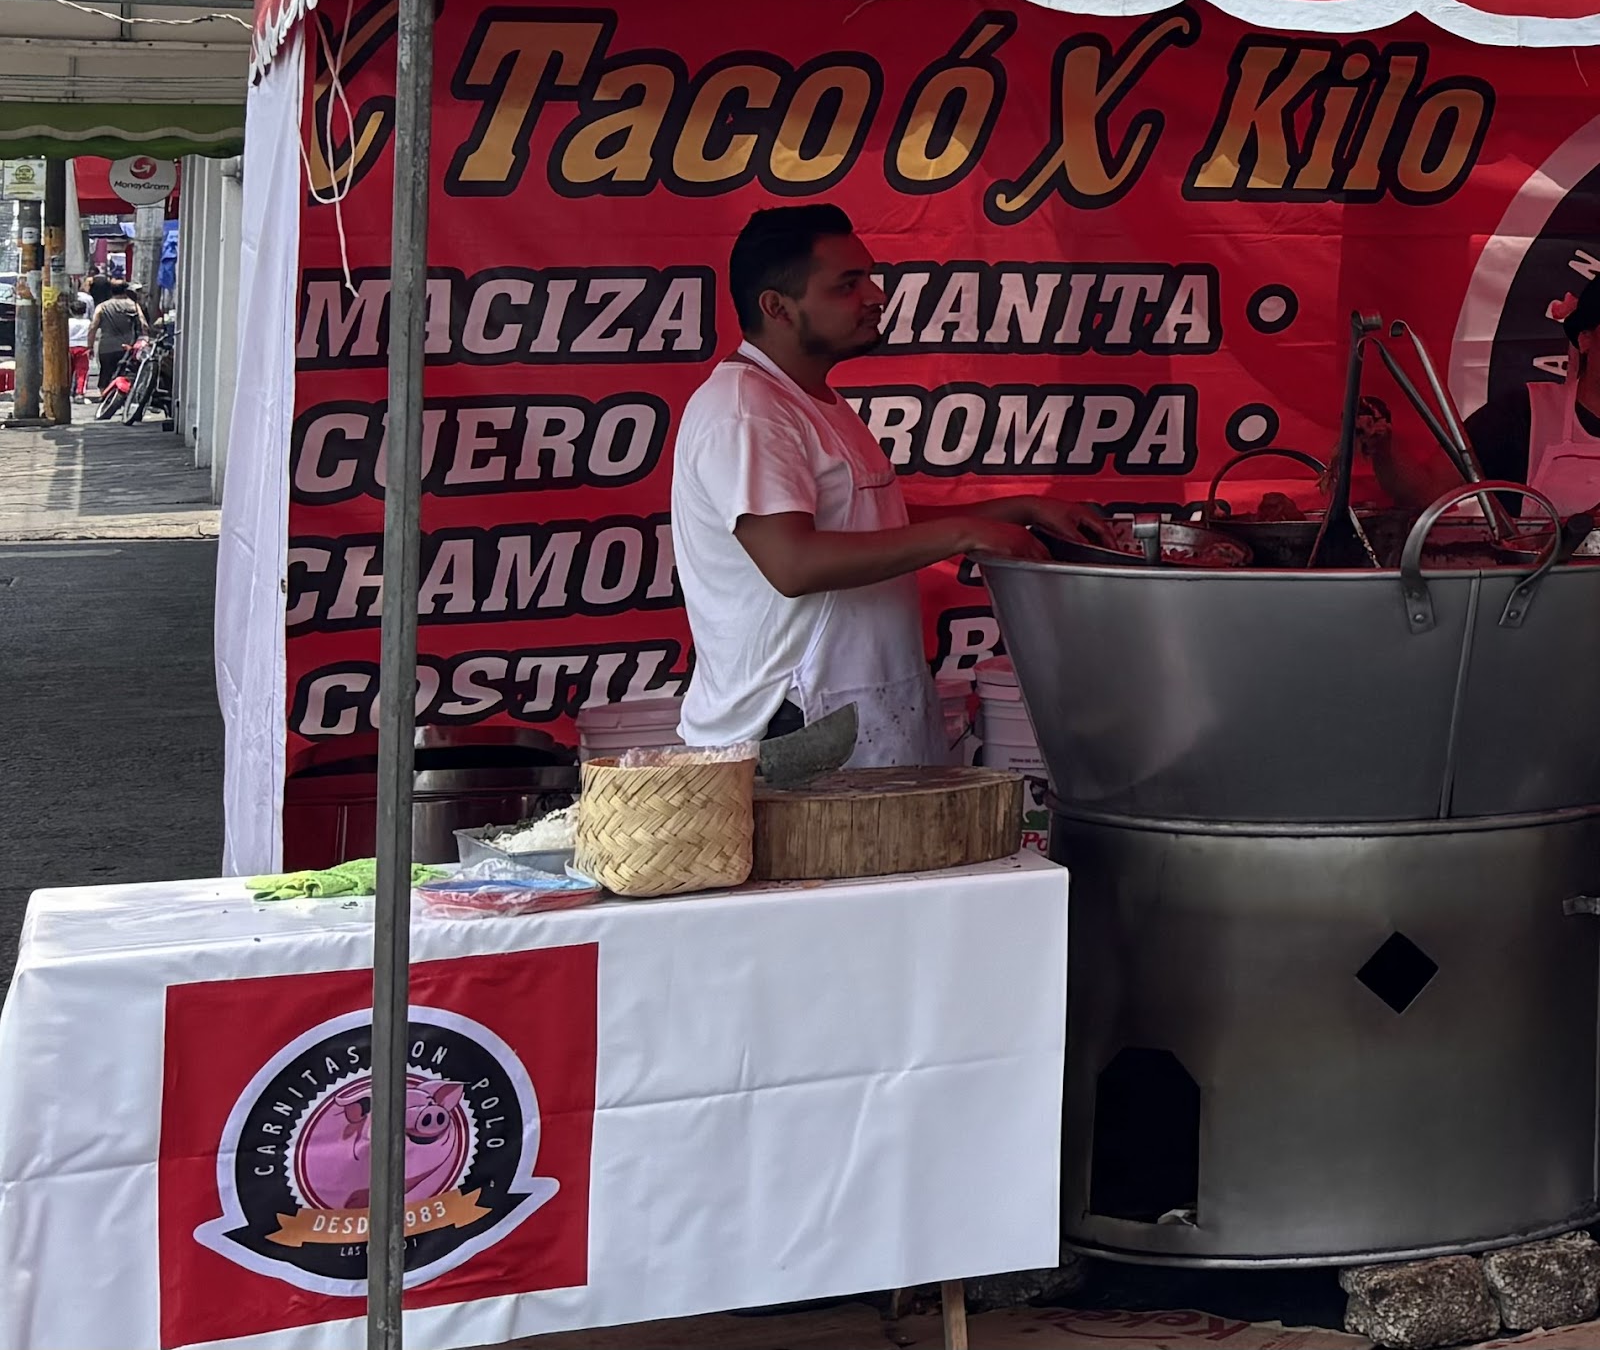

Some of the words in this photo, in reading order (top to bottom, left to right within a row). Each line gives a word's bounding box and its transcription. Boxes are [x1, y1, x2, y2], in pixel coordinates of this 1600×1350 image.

[456, 19, 875, 185] Taco
[894, 23, 1005, 182] ó
[994, 16, 1192, 213] X
[1192, 44, 1489, 195] Kilo
[113, 180, 171, 192] MoneyGram
[253, 1046, 361, 1177] CARNITAS
[410, 1040, 449, 1065] ON
[471, 1076, 507, 1150] POLO
[313, 1215, 370, 1236] DESD
[406, 1200, 448, 1229] 983
